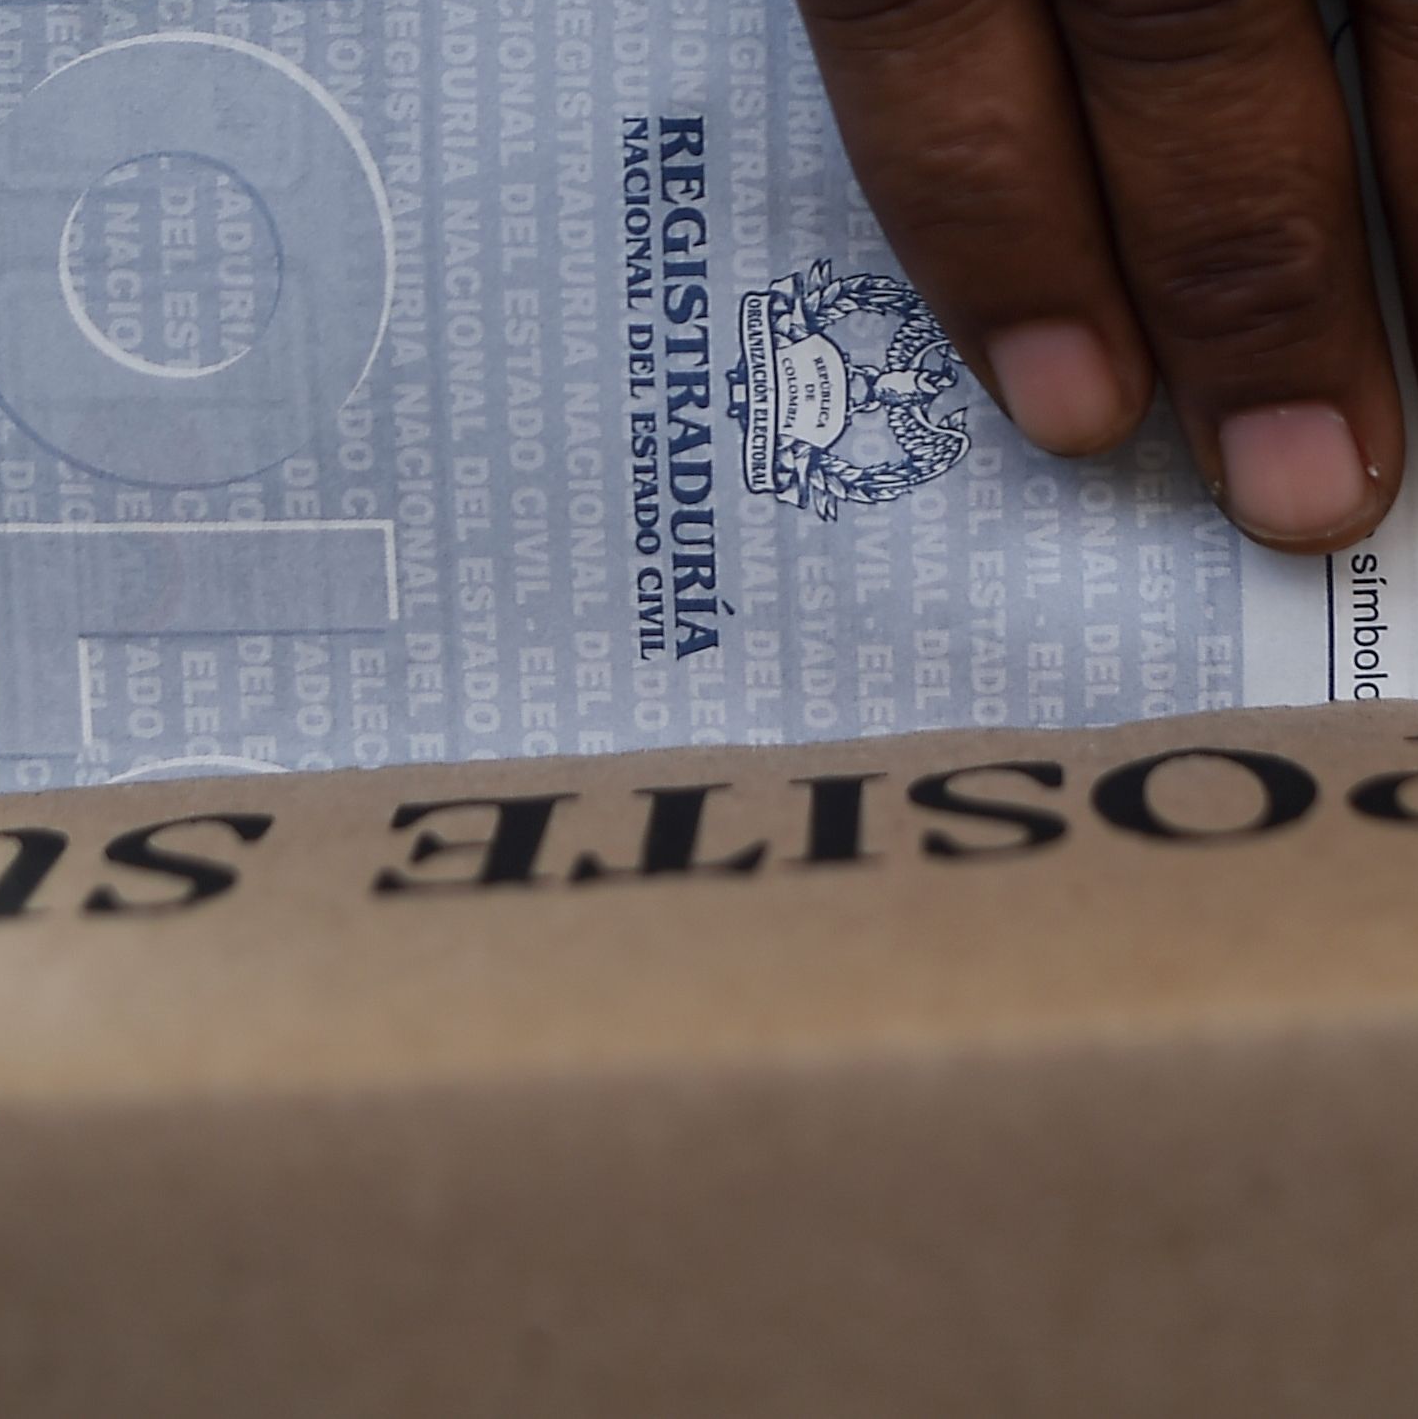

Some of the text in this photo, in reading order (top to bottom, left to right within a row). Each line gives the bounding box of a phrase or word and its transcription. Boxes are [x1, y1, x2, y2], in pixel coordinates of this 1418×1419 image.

[500, 183, 536, 273] DEL
[622, 117, 653, 310] NACIONAL
[442, 200, 485, 440] NACIONAL
[629, 324, 656, 399] DEL
[503, 289, 545, 472] ESTADO
[660, 115, 734, 661] REGISTRADURÍA
[747, 299, 773, 487] ORGANIZACIÓN ELECTORAL
[782, 357, 798, 429] COLOMBIA
[805, 384, 813, 401] DE
[813, 356, 832, 429] REPÚBLICA
[393, 383, 437, 618] NACIONAL
[452, 457, 493, 542] DEL
[512, 486, 550, 605] CIVIL
[563, 382, 607, 617] NACIONAL
[631, 418, 661, 555] ESTADO
[458, 557, 501, 735] ESTADO
[575, 631, 611, 716] DEL
[637, 567, 665, 661] CIVIL
[404, 632, 442, 718] DEL
